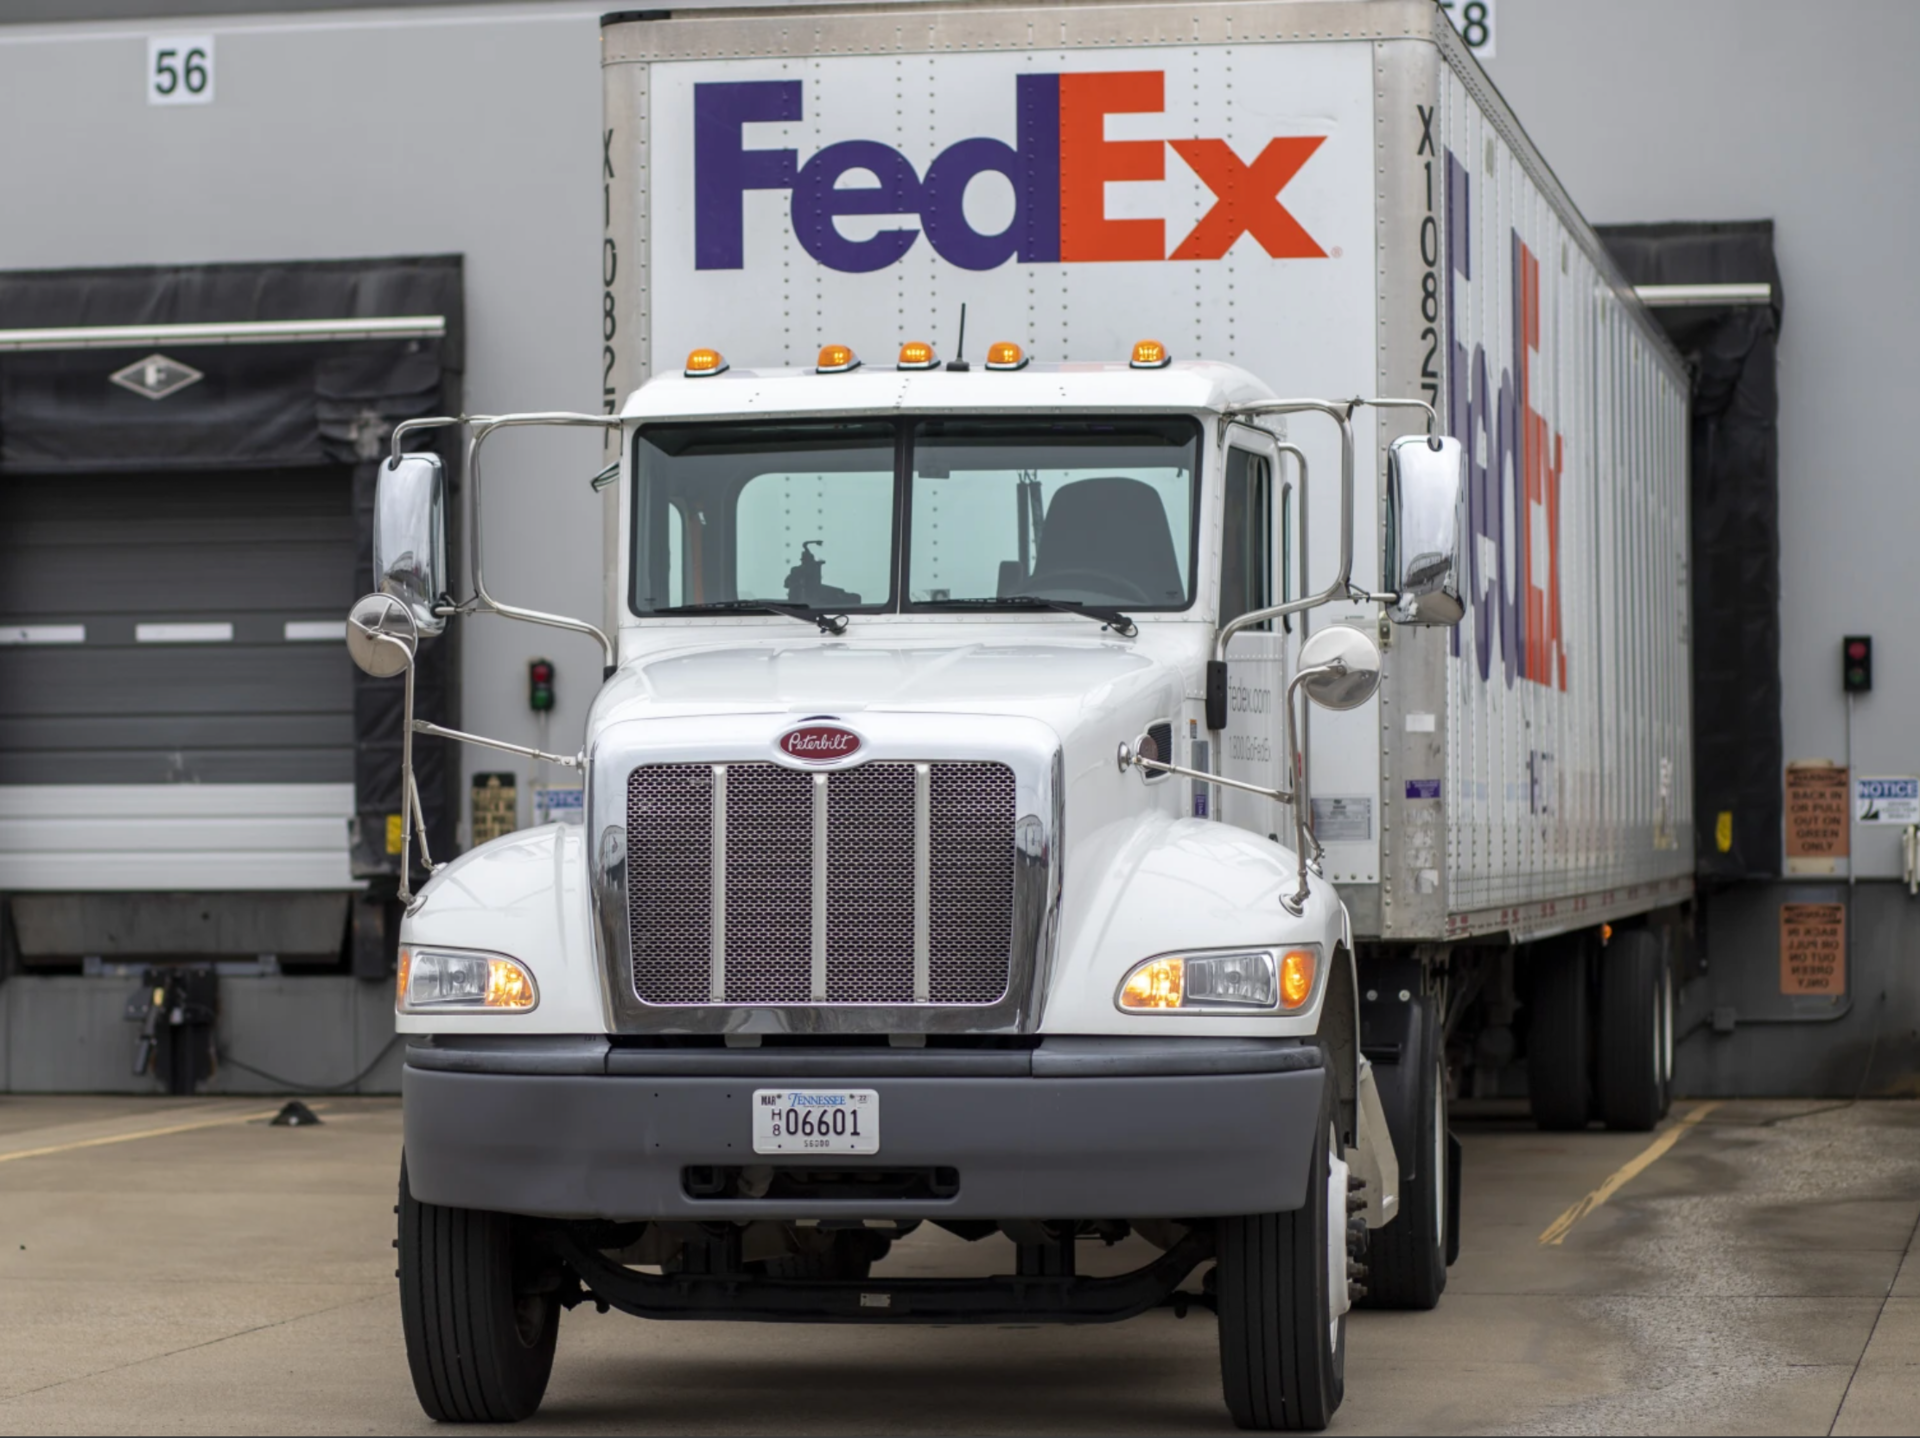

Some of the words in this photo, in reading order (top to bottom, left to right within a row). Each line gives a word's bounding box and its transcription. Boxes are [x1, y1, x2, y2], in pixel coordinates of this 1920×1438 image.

[1441, 2, 1488, 47] 8
[156, 49, 207, 94] 56
[694, 70, 1329, 273] FedEx
[788, 732, 854, 752] Peterbilt
[1792, 790, 1826, 800] BACK
[1830, 790, 1842, 800] IN
[1859, 782, 1917, 797] NOTICE
[1791, 803, 1808, 813] OR
[1813, 803, 1842, 813] PULL
[1794, 816, 1819, 826] OUT
[1823, 816, 1841, 826] ON
[1796, 828, 1839, 838] GREEN
[1801, 842, 1833, 852] ONLY
[761, 1095, 776, 1106] MAR
[785, 1108, 861, 1137] 06601
